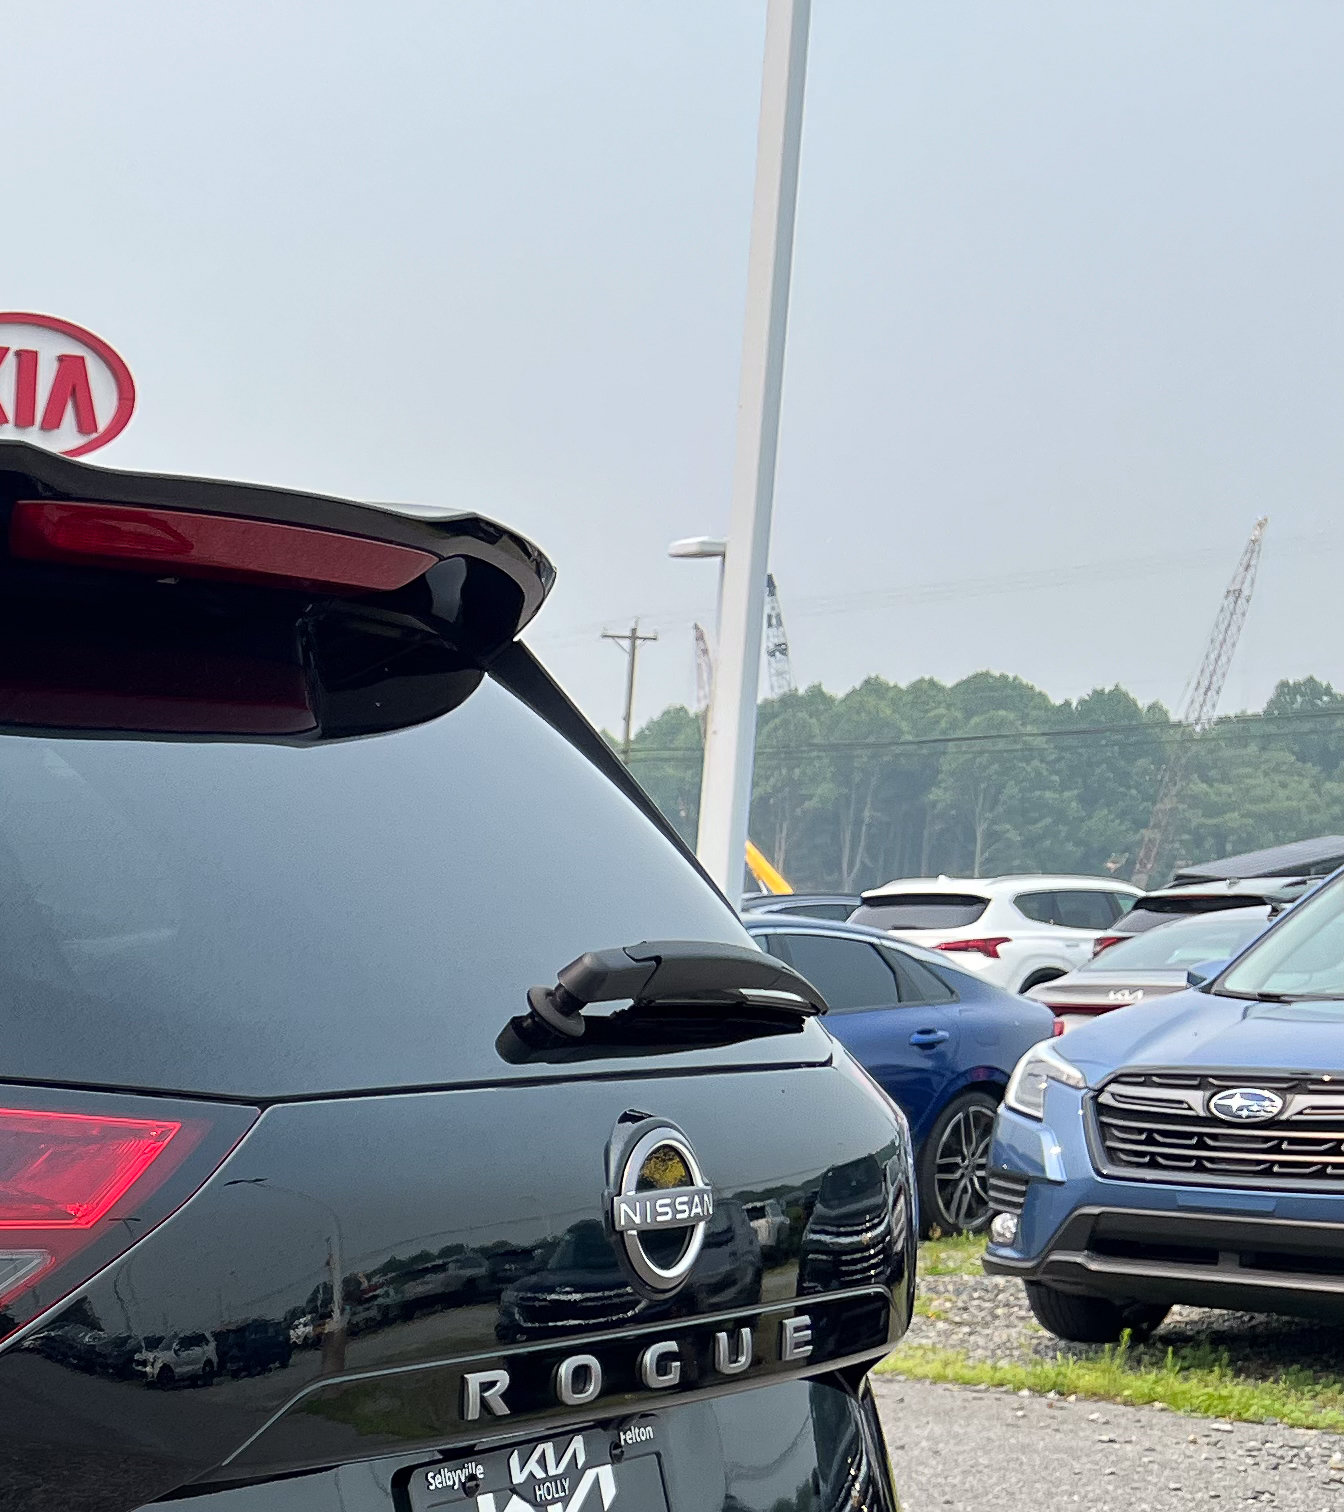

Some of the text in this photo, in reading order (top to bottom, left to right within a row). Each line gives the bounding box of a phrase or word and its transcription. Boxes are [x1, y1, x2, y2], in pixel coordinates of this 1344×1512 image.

[619, 1193, 713, 1227] NISSAN
[463, 1314, 814, 1421] ROGUE
[427, 1461, 485, 1491] Selbyville
[509, 1434, 586, 1485] KIA
[535, 1477, 571, 1502] HOLLY
